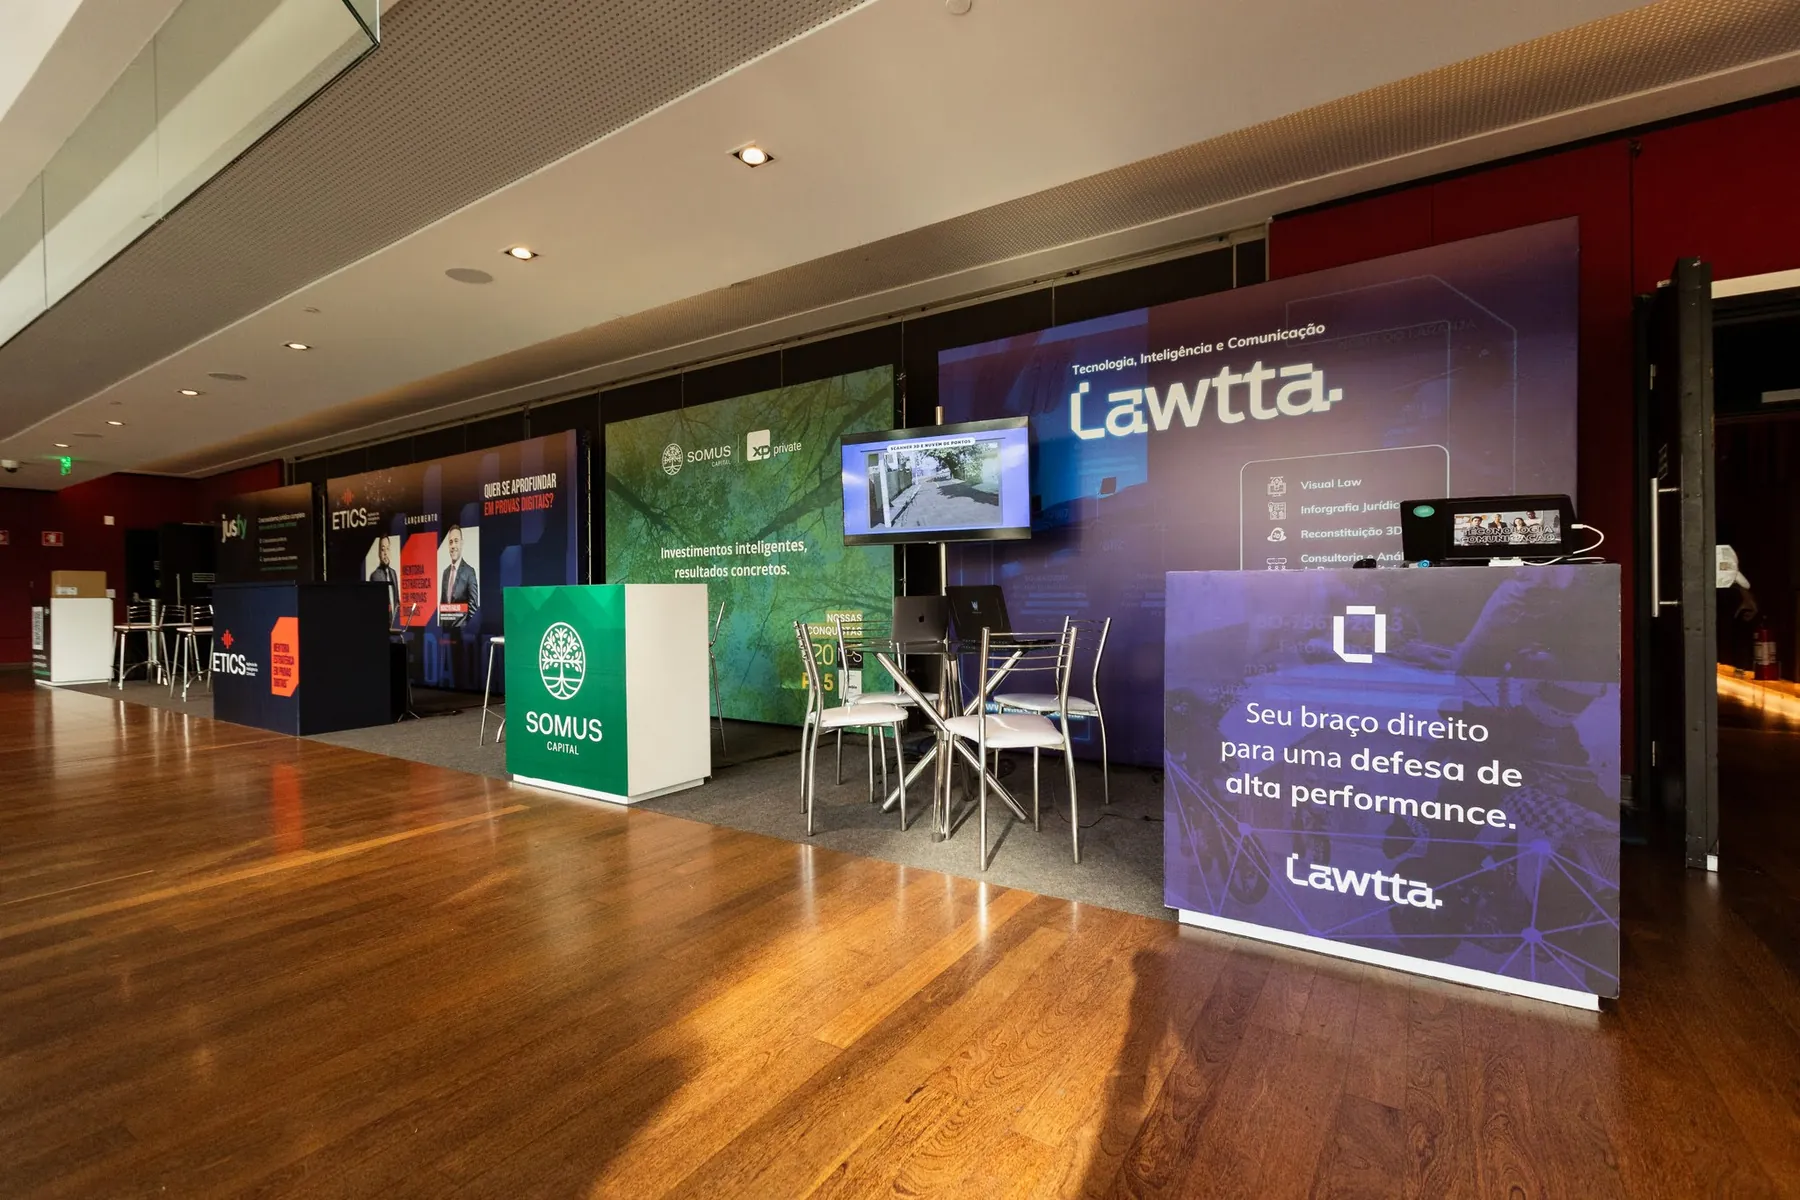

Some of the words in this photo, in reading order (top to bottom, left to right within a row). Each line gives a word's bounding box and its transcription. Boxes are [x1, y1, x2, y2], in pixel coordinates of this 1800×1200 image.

[1072, 357, 1137, 375] Tecnologia,
[1140, 342, 1213, 365] Inteligência
[1216, 341, 1224, 351] e
[1228, 323, 1326, 350] Comunicação
[687, 445, 731, 463] SOMUS
[773, 441, 802, 456] private
[484, 482, 501, 499] QUER
[501, 480, 511, 496] SE
[511, 473, 557, 494] APROFUNDAR
[1300, 479, 1334, 490] Visual
[1337, 478, 1362, 488] Law
[484, 501, 494, 516] EM
[495, 497, 520, 515] PROVAS
[521, 492, 554, 511] DIGITAIS?
[1301, 503, 1359, 516] Inforgrafia
[1363, 500, 1401, 513] Jurídic
[332, 507, 367, 530] ETICS
[404, 513, 438, 525] LANÇAMENTO
[1301, 528, 1383, 540] Reconstituição
[1386, 526, 1402, 536] 3D
[661, 545, 733, 559] Investimentos
[735, 540, 807, 557] inteligentes,
[1301, 552, 1363, 563] Consultoria
[1377, 551, 1404, 561] Anál
[674, 565, 729, 579] resultados
[731, 564, 790, 577] concretos.
[826, 613, 863, 623] NOSSAS
[808, 625, 863, 636] CONQUSTAS
[213, 652, 246, 675] ETICS
[526, 711, 603, 742] SOMUS
[1246, 702, 1292, 726] Seu
[1301, 705, 1378, 737] braço
[1387, 712, 1489, 743] direito
[546, 741, 579, 755] CAPITAL
[1221, 741, 1275, 762] para
[1284, 747, 1342, 769] uma
[1350, 748, 1464, 782] defesa
[1477, 760, 1523, 787] de
[1225, 773, 1280, 799] alta
[1291, 784, 1516, 830] performance.
